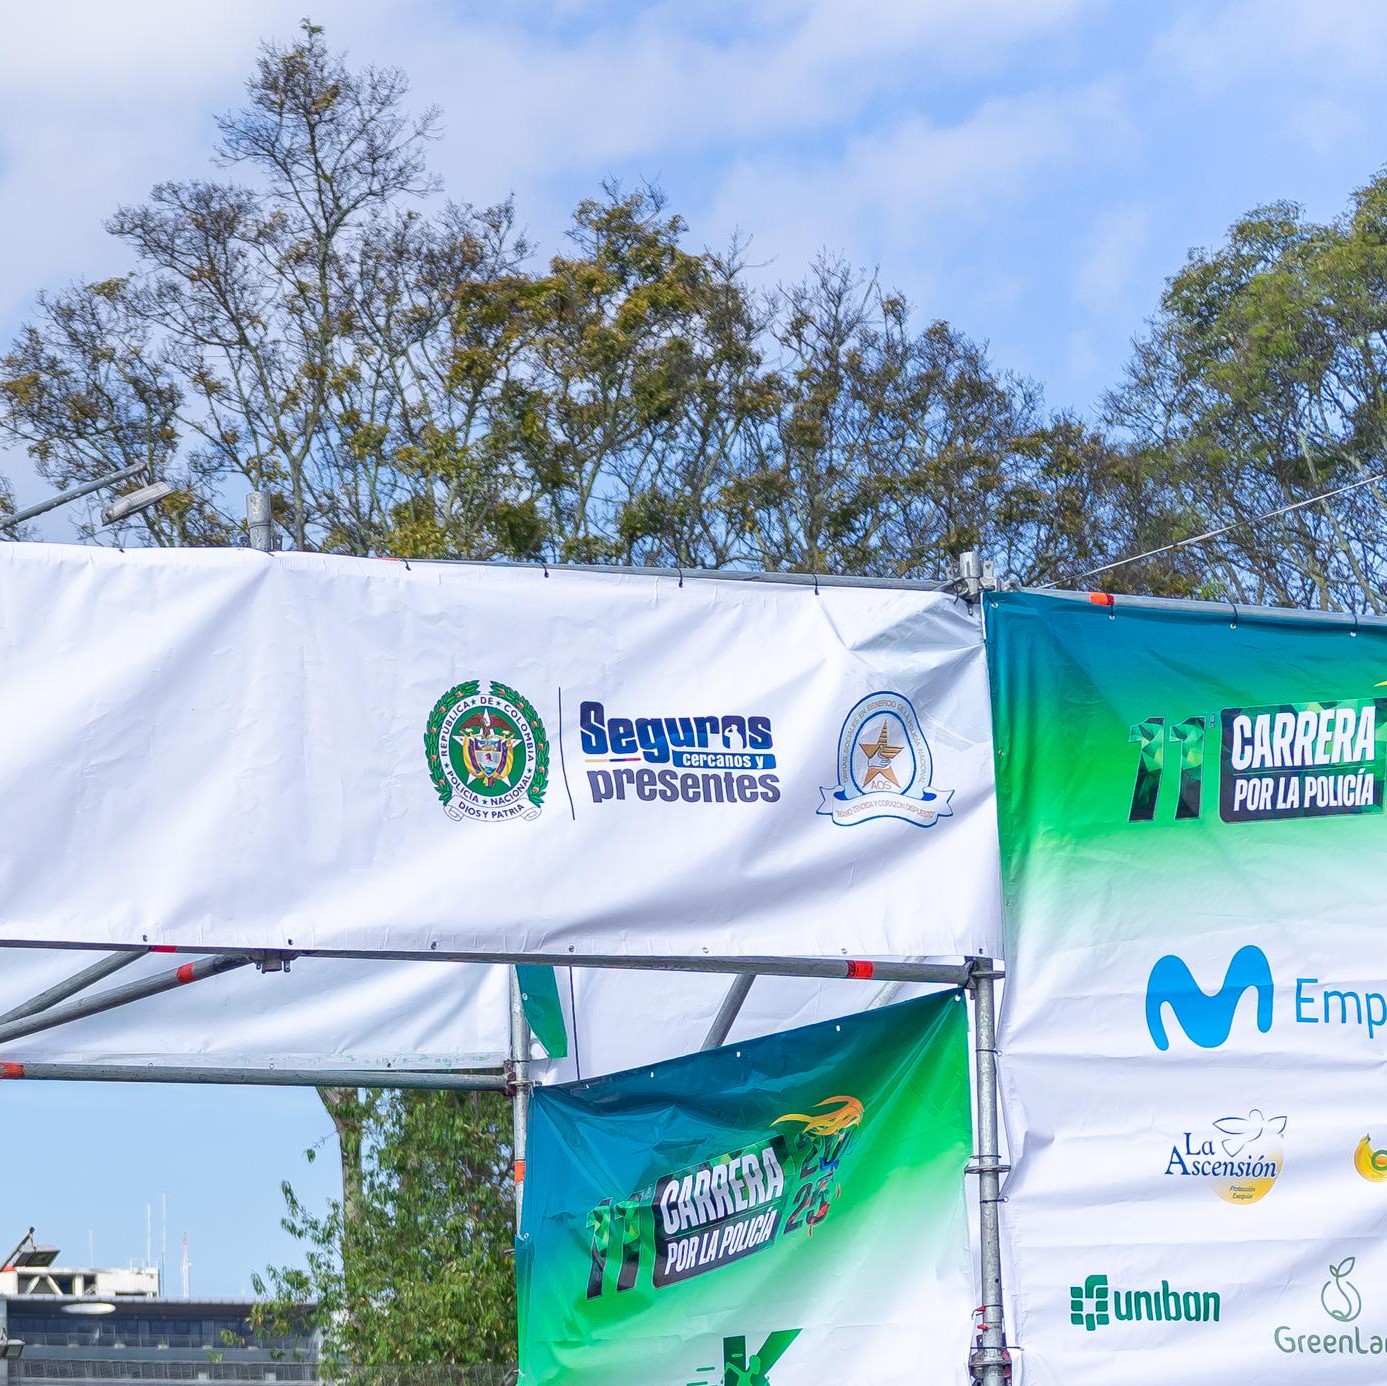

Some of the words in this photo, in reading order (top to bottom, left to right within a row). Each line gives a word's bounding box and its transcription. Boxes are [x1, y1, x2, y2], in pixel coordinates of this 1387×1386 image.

[480, 696, 494, 705] DE
[503, 704, 534, 762] COLOMBIA
[580, 700, 773, 764] Seguros
[1231, 706, 1376, 770] CARRERA
[682, 753, 752, 770] cercanos
[755, 756, 765, 771] y
[491, 774, 532, 806] NACIONAL
[587, 767, 781, 804] presentes
[871, 780, 891, 790] AOS
[1233, 778, 1274, 811] POR
[1276, 777, 1299, 809] LA
[1304, 768, 1374, 808] POLICÍA
[492, 804, 525, 818] PATRIA
[1164, 1145, 1276, 1178] Ascensión
[1185, 1132, 1215, 1155] La
[660, 1146, 784, 1235] CARRERA
[664, 1237, 698, 1275] POR
[698, 1232, 718, 1265] LA
[718, 1206, 777, 1259] POLICÍA
[1113, 1280, 1220, 1322] uniban
[1274, 1326, 1387, 1355] GreenLa
